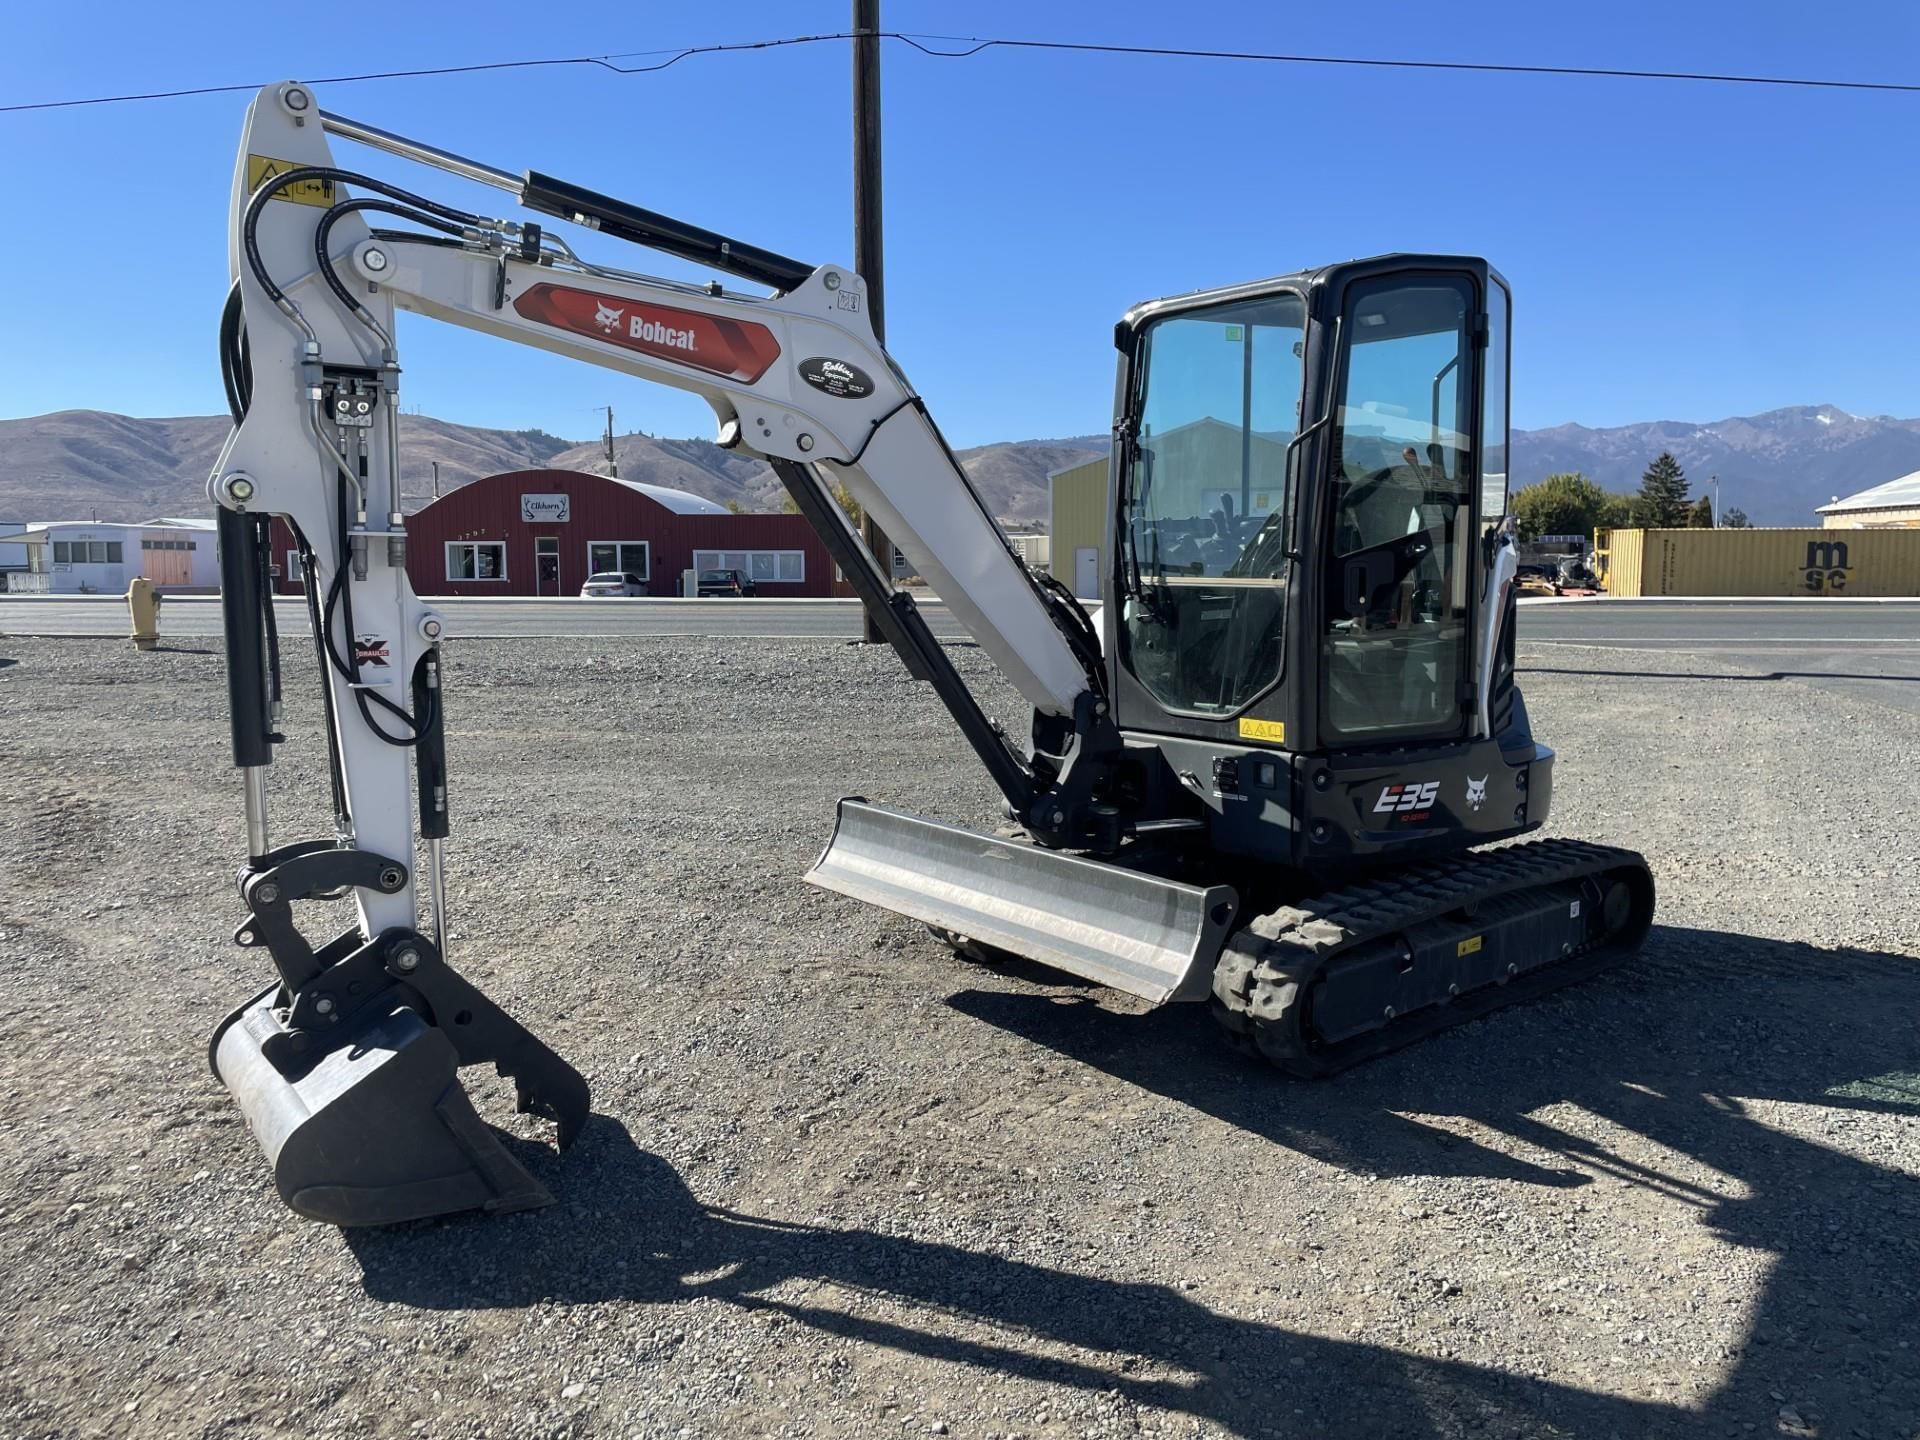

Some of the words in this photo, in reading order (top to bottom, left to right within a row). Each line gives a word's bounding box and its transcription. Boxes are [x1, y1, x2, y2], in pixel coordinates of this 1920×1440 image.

[629, 315, 695, 351] Bobcat
[530, 502, 560, 510] Elkhorn
[1372, 781, 1441, 813] E35
